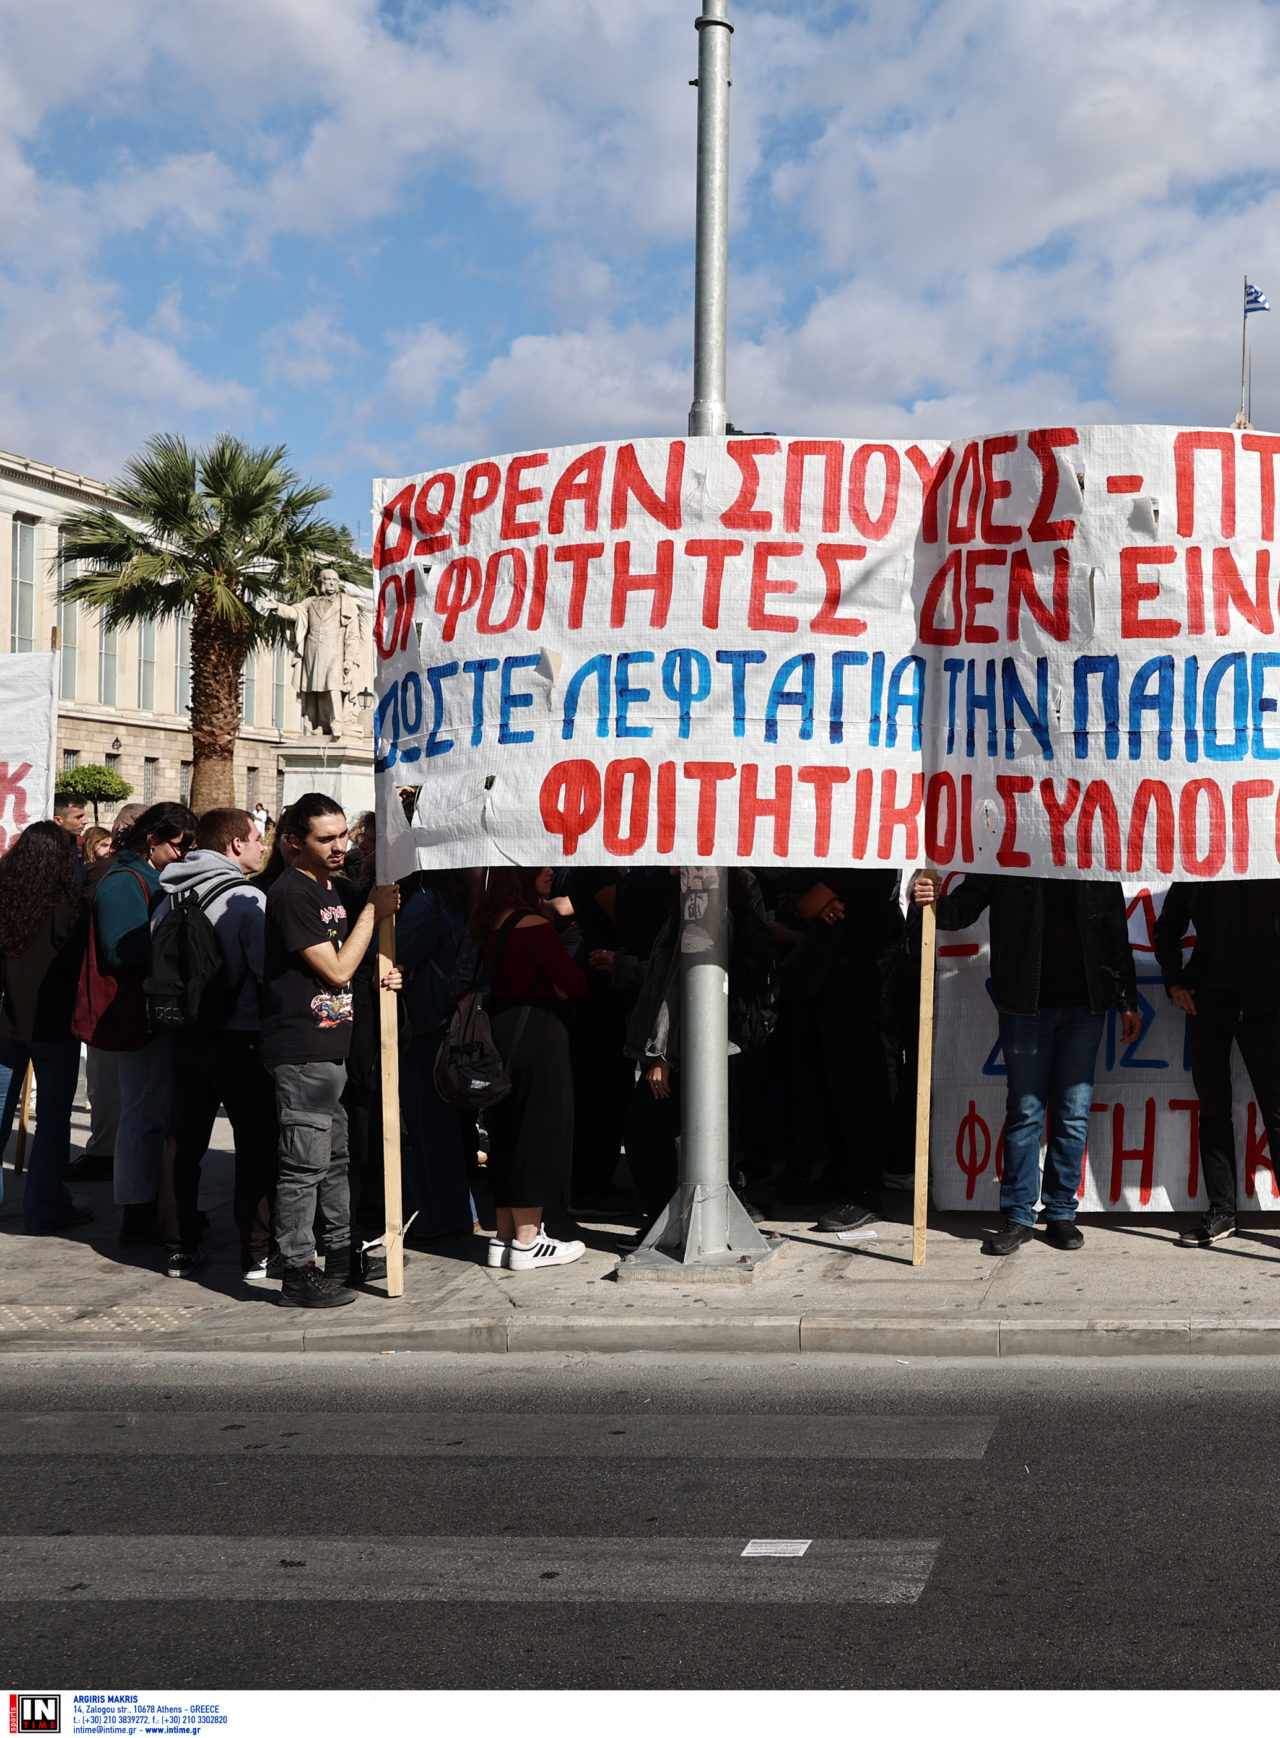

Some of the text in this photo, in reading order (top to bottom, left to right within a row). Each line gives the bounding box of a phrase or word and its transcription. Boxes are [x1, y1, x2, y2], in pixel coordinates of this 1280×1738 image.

[373, 440, 686, 570] ΔΩΡΕΑΝ
[720, 427, 1079, 545] ΣΠΟΥΔΕΣ
[373, 568, 417, 660] ΟΙ
[434, 539, 868, 643] ΦΟΙΤΗΤΕΣ
[919, 547, 1071, 647] ΔΕΝ
[943, 657, 1055, 761] ΤΗΝ
[539, 758, 974, 868] ΦΟΙΤΗΤΙΚΟΙ
